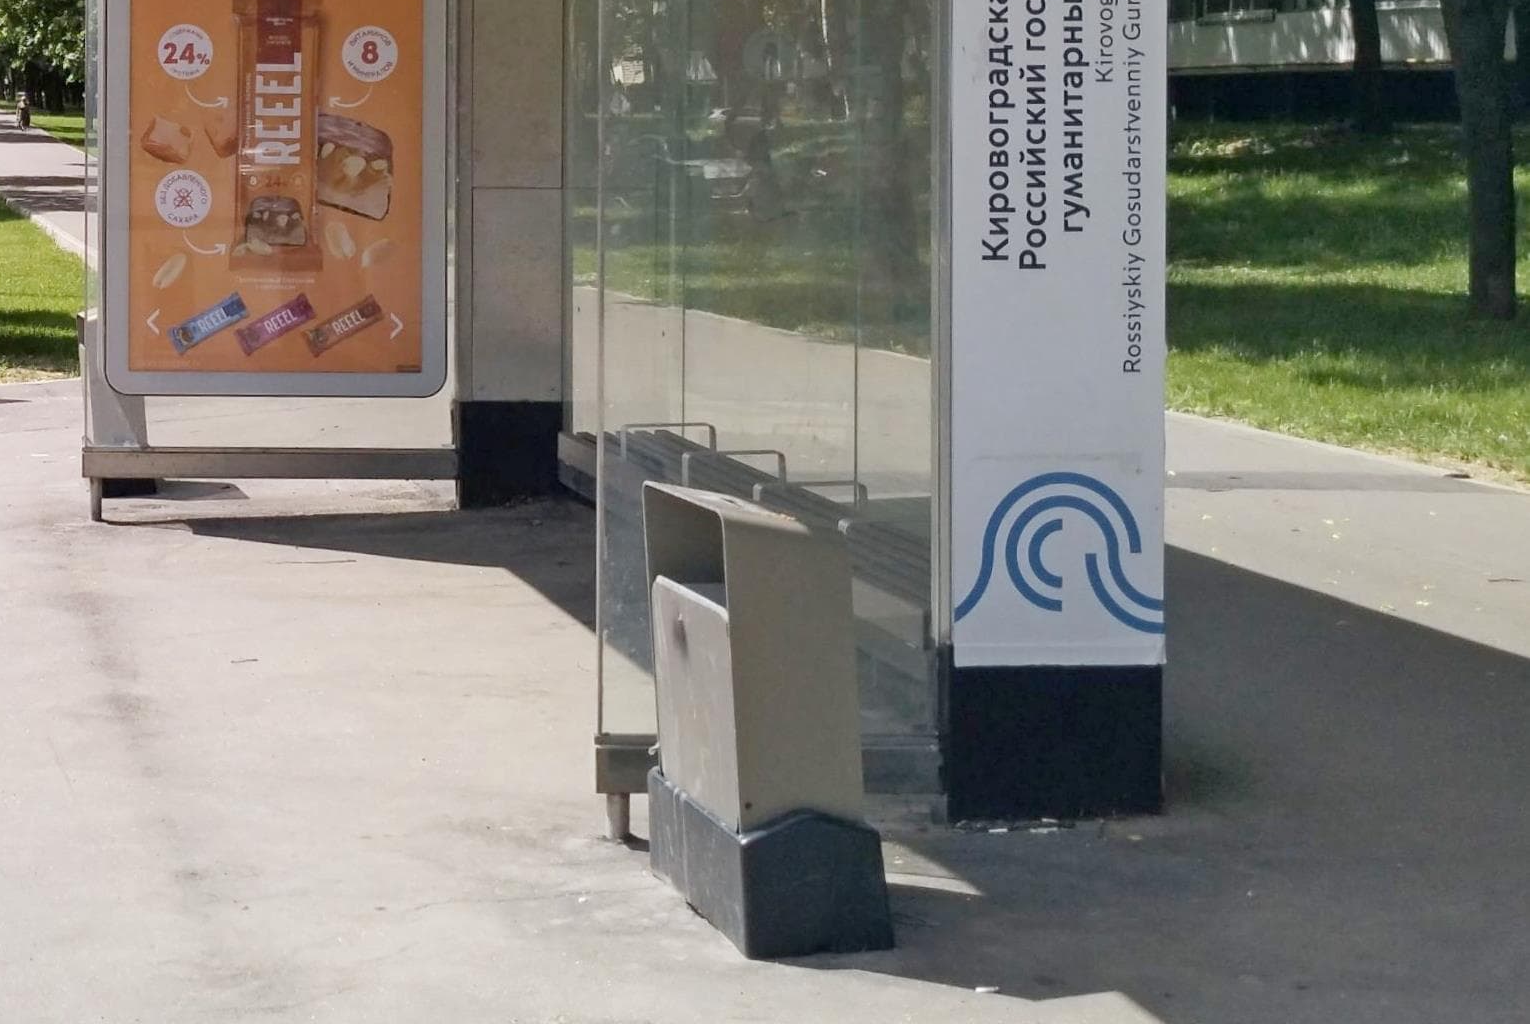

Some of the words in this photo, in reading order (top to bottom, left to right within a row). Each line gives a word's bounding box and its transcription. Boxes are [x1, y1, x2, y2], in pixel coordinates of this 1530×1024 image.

[163, 42, 211, 65] 24%
[361, 40, 379, 65] 8
[255, 52, 302, 164] REEEL
[1121, 47, 1145, 246] Gosudarstvenniy
[1018, 64, 1047, 270] Российский
[197, 307, 230, 334] REEEL
[264, 308, 298, 335] REEEL
[332, 310, 367, 336] REEEL
[1121, 252, 1146, 373] Rossiyskiy
